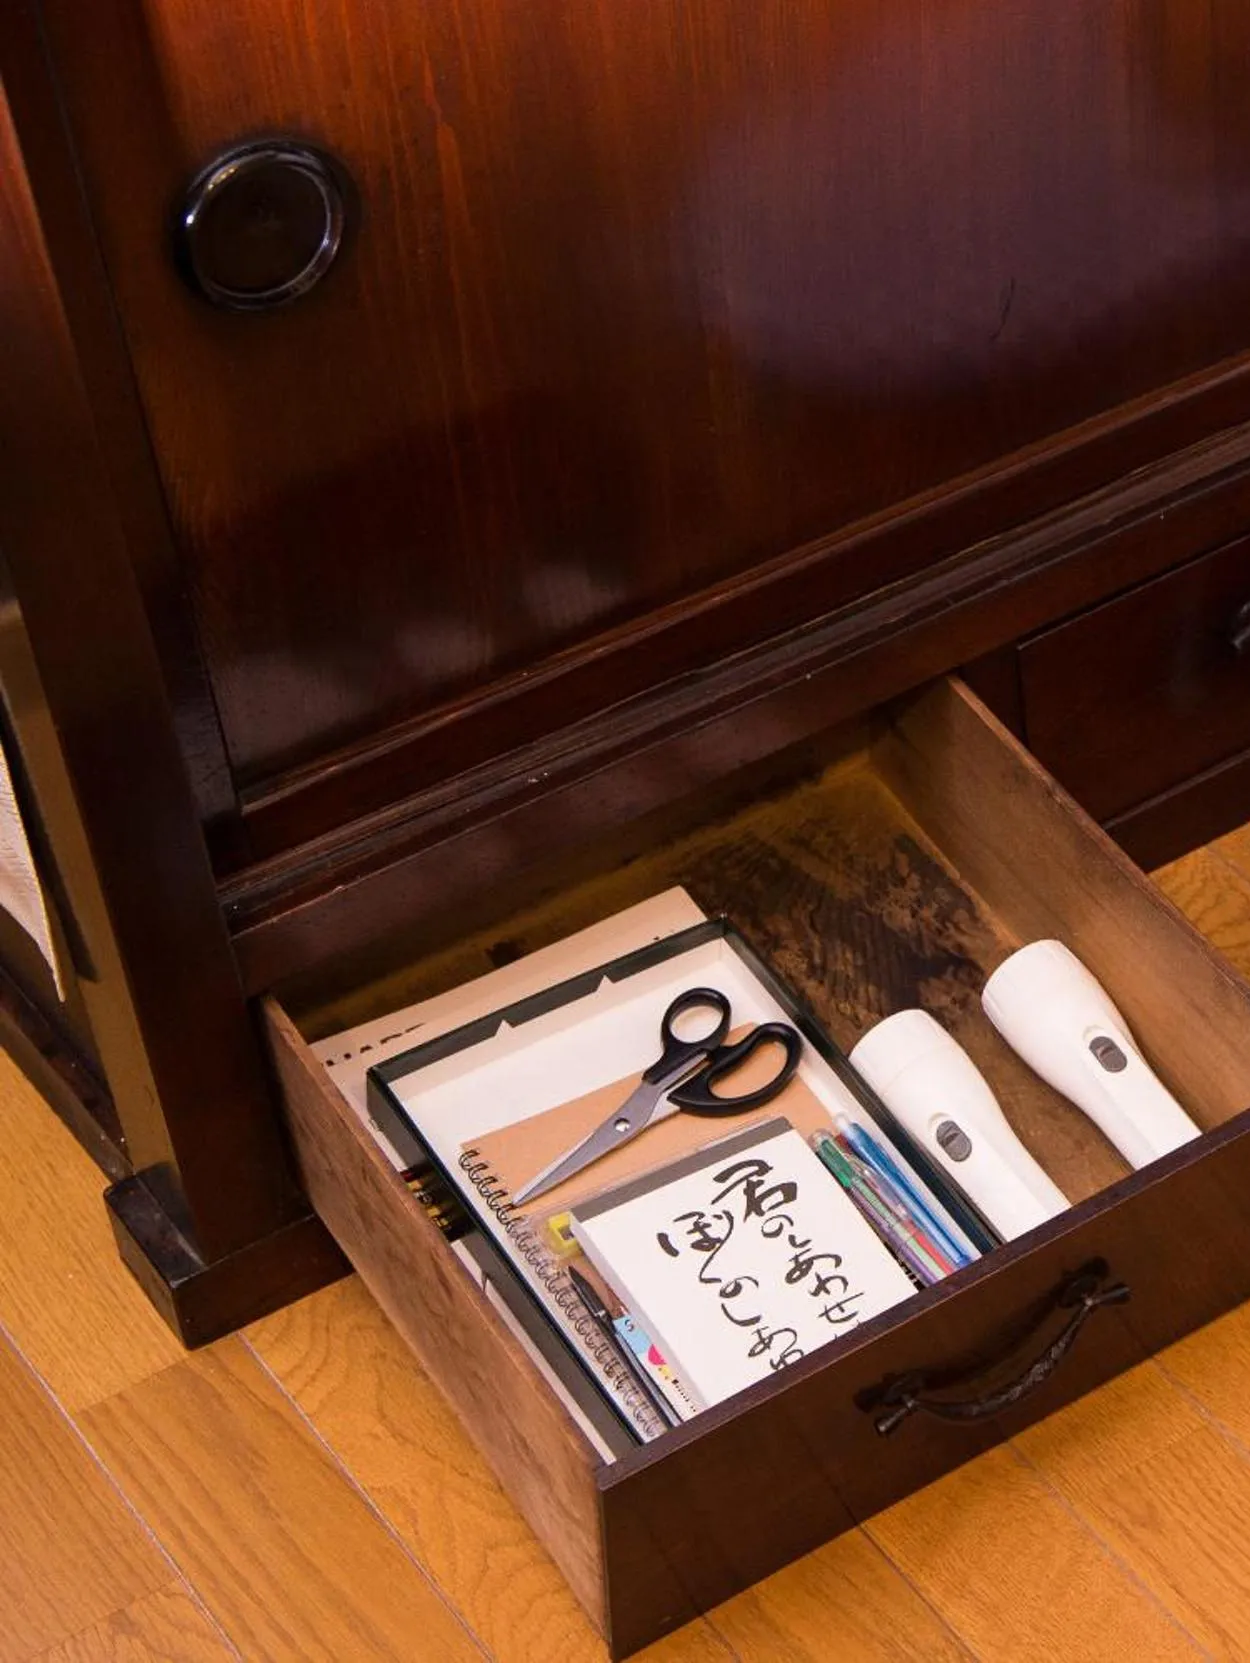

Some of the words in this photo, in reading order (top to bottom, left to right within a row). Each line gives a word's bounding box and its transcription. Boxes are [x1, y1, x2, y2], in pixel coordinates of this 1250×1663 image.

[711, 1158, 866, 1339] 君のしあわせ
